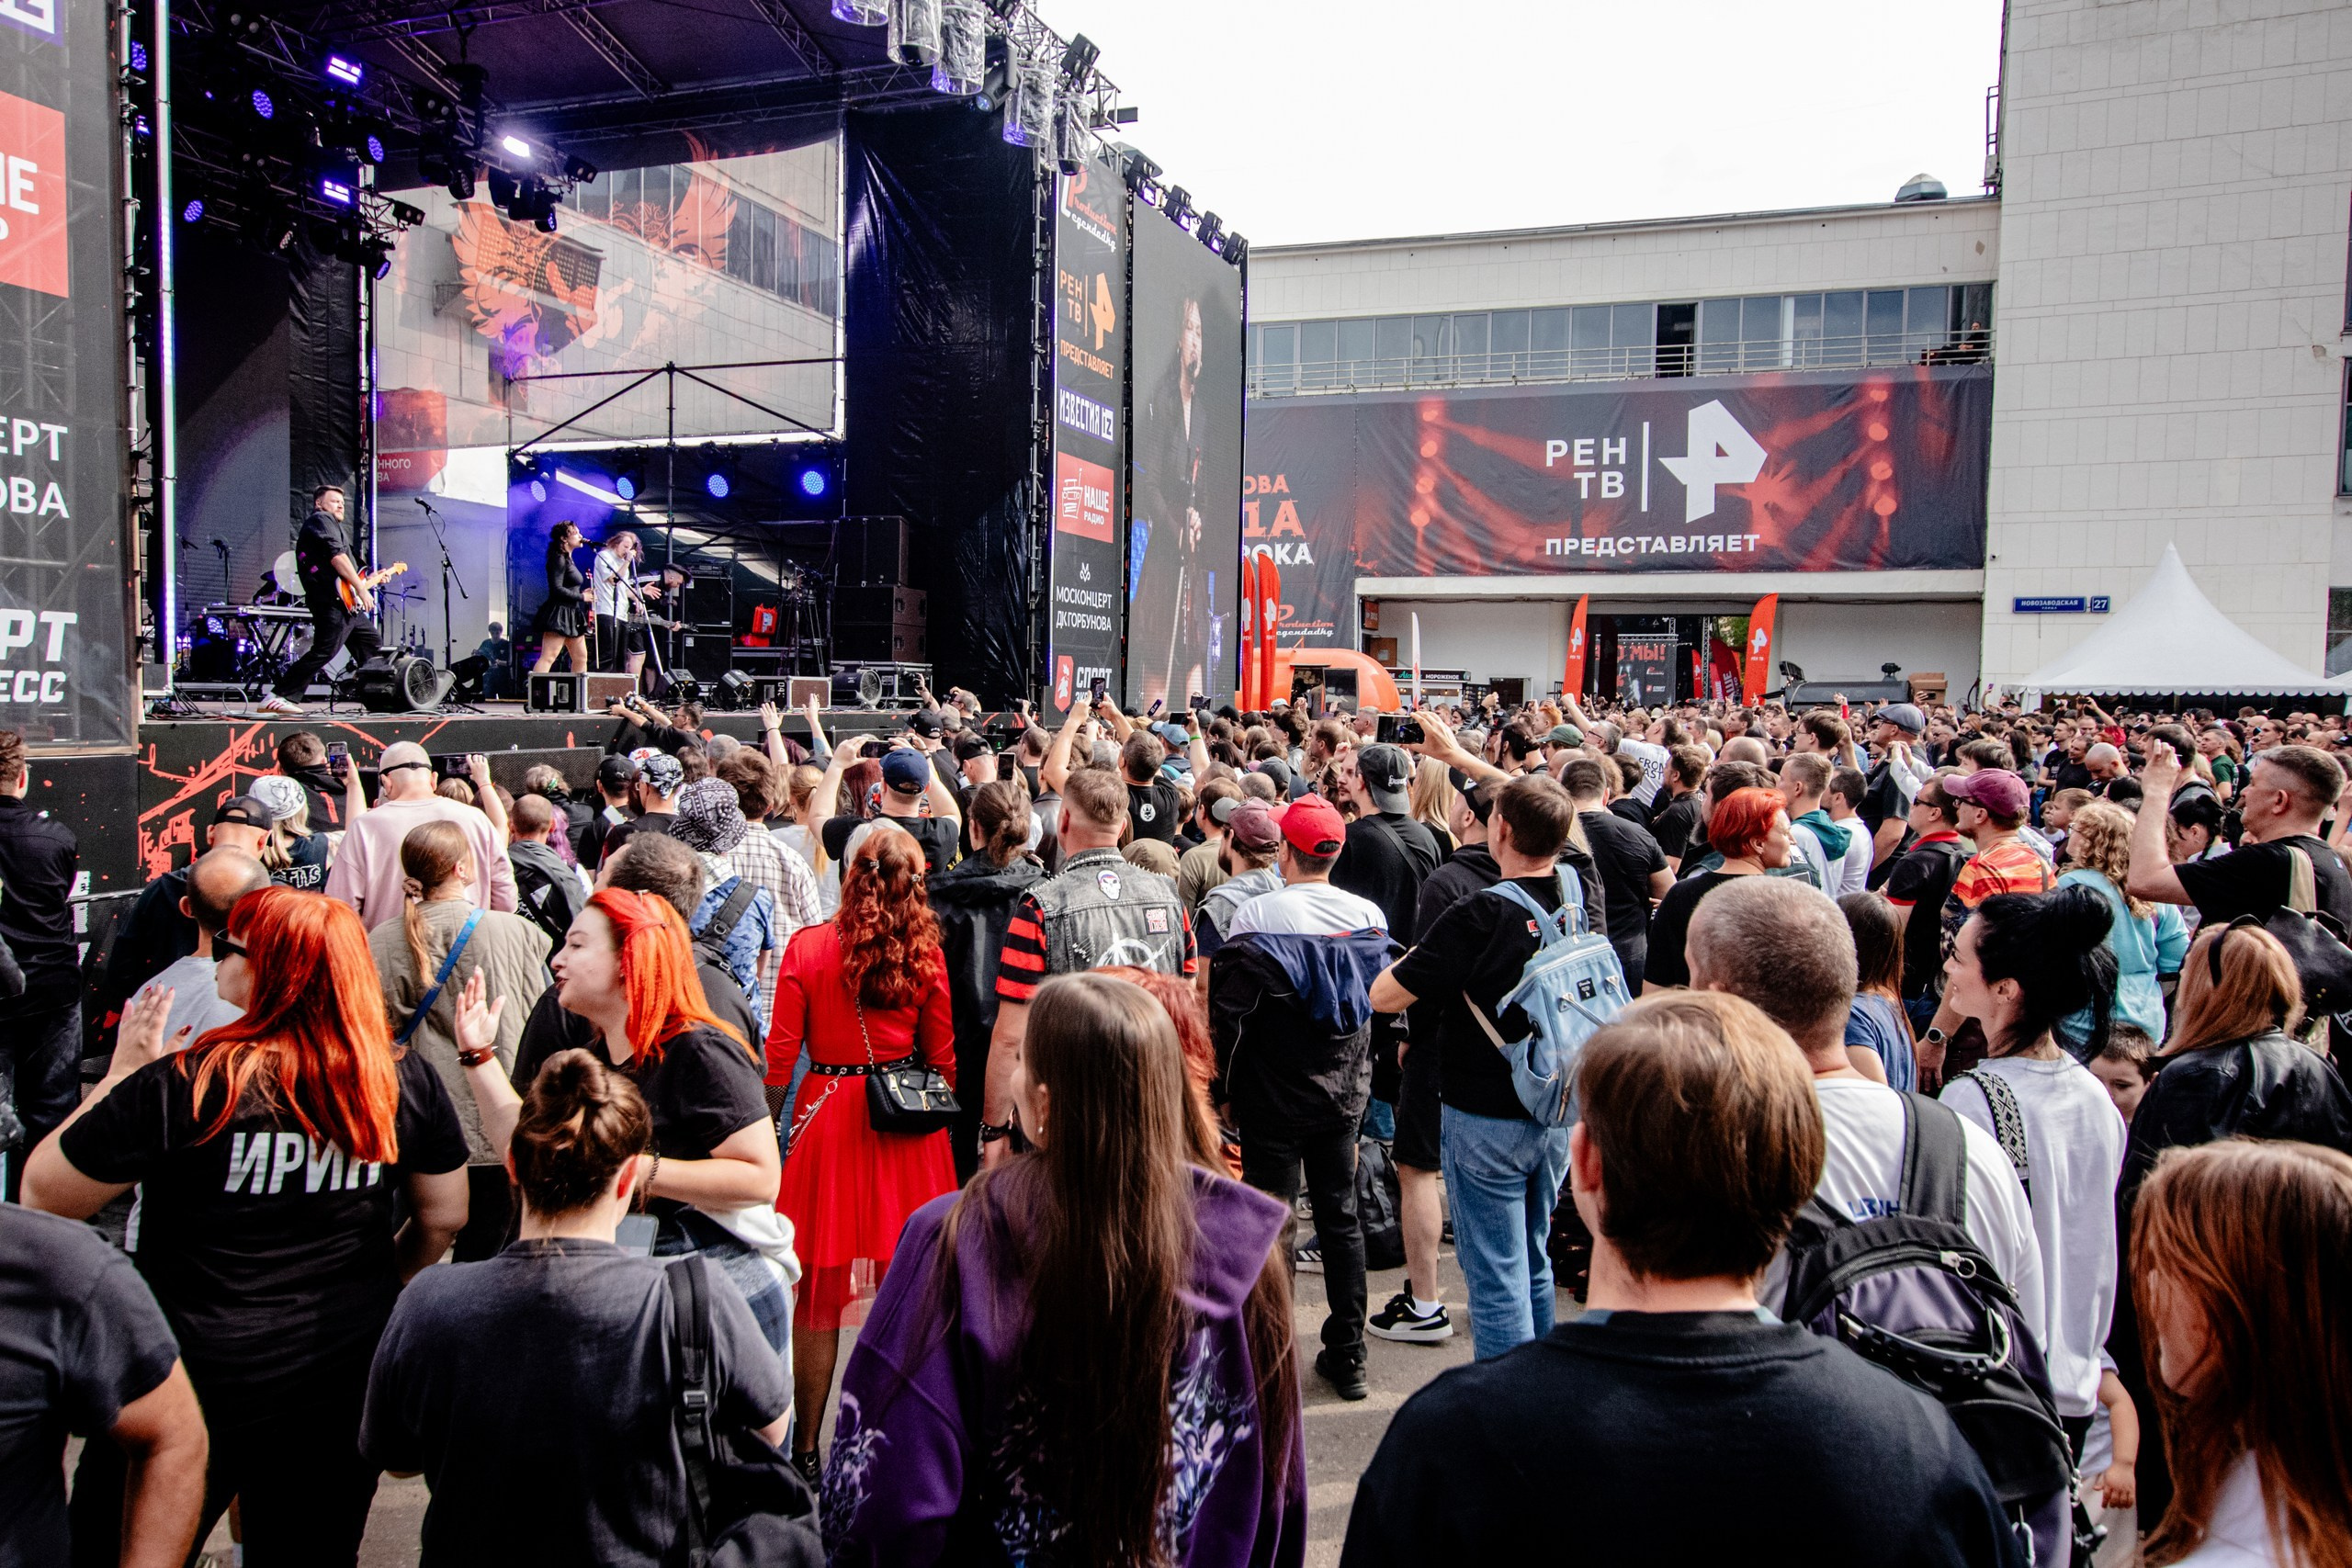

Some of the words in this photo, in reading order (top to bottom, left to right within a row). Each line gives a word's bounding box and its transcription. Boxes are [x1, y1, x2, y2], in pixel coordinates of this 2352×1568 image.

[0, 151, 40, 215] Е
[1059, 269, 1082, 299] РЕН
[1067, 298, 1082, 323] ТВ
[1060, 339, 1114, 379] ПРЕДСТАВЛЯЕТ
[1059, 388, 1100, 436] ИЗВЕСТИЯ
[1545, 436, 1626, 467] РЕН
[1573, 470, 1625, 499] ТВ
[1084, 485, 1110, 513] НАШЕ
[1083, 511, 1105, 525] РАДИО
[1545, 534, 1760, 558] ПРЕДСТАВЛЯЕТ
[1056, 585, 1113, 609] МОСКОНЦЕРТ
[2094, 599, 2108, 609] 27
[1068, 612, 1112, 632] ГОРБУНОВА
[1630, 644, 1666, 661] МЫ!
